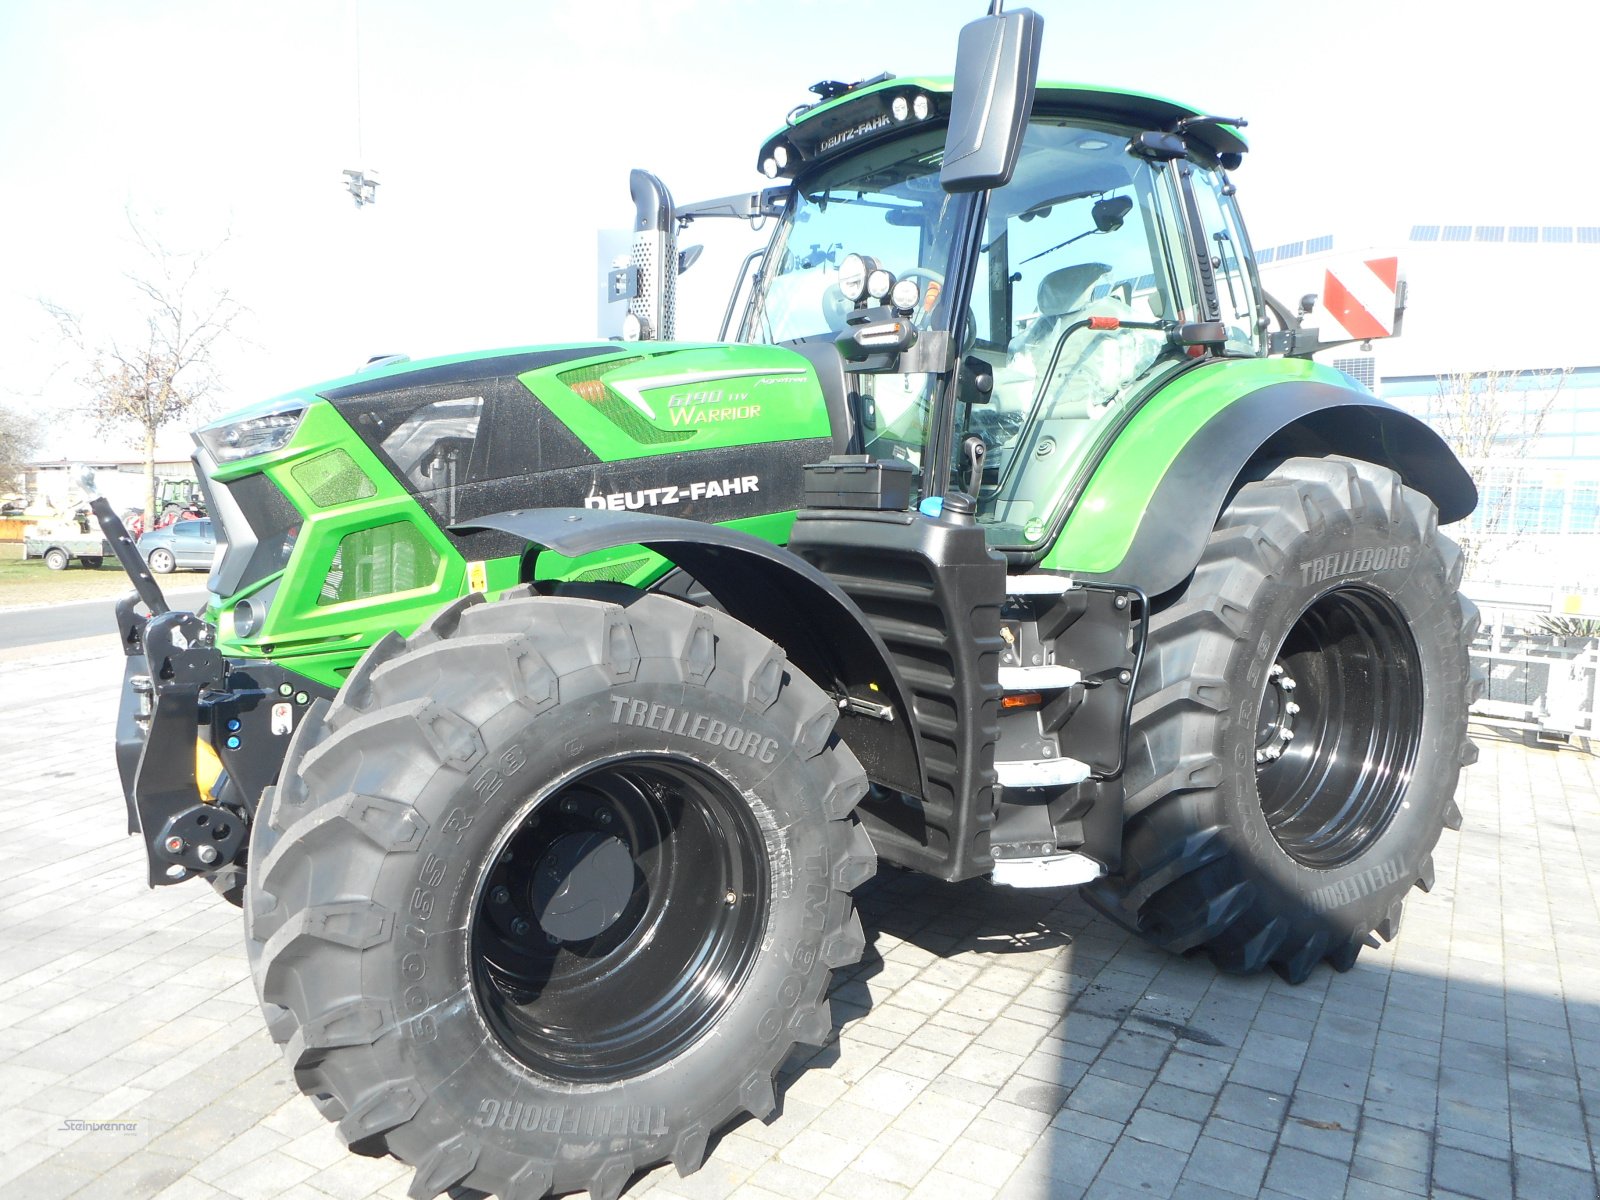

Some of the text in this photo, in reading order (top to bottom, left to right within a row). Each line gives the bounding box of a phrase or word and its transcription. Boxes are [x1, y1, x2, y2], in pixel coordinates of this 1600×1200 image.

[820, 113, 891, 153] DEUTZ-FAHR
[668, 389, 724, 408] 6190
[584, 475, 760, 511] DEUTZ-FAHR
[1299, 544, 1411, 588] TRELLEBORG
[610, 693, 779, 765] TRELLEBORG
[1304, 852, 1411, 915] TRELLEBOR
[473, 1097, 671, 1137] TRELLEBORG
